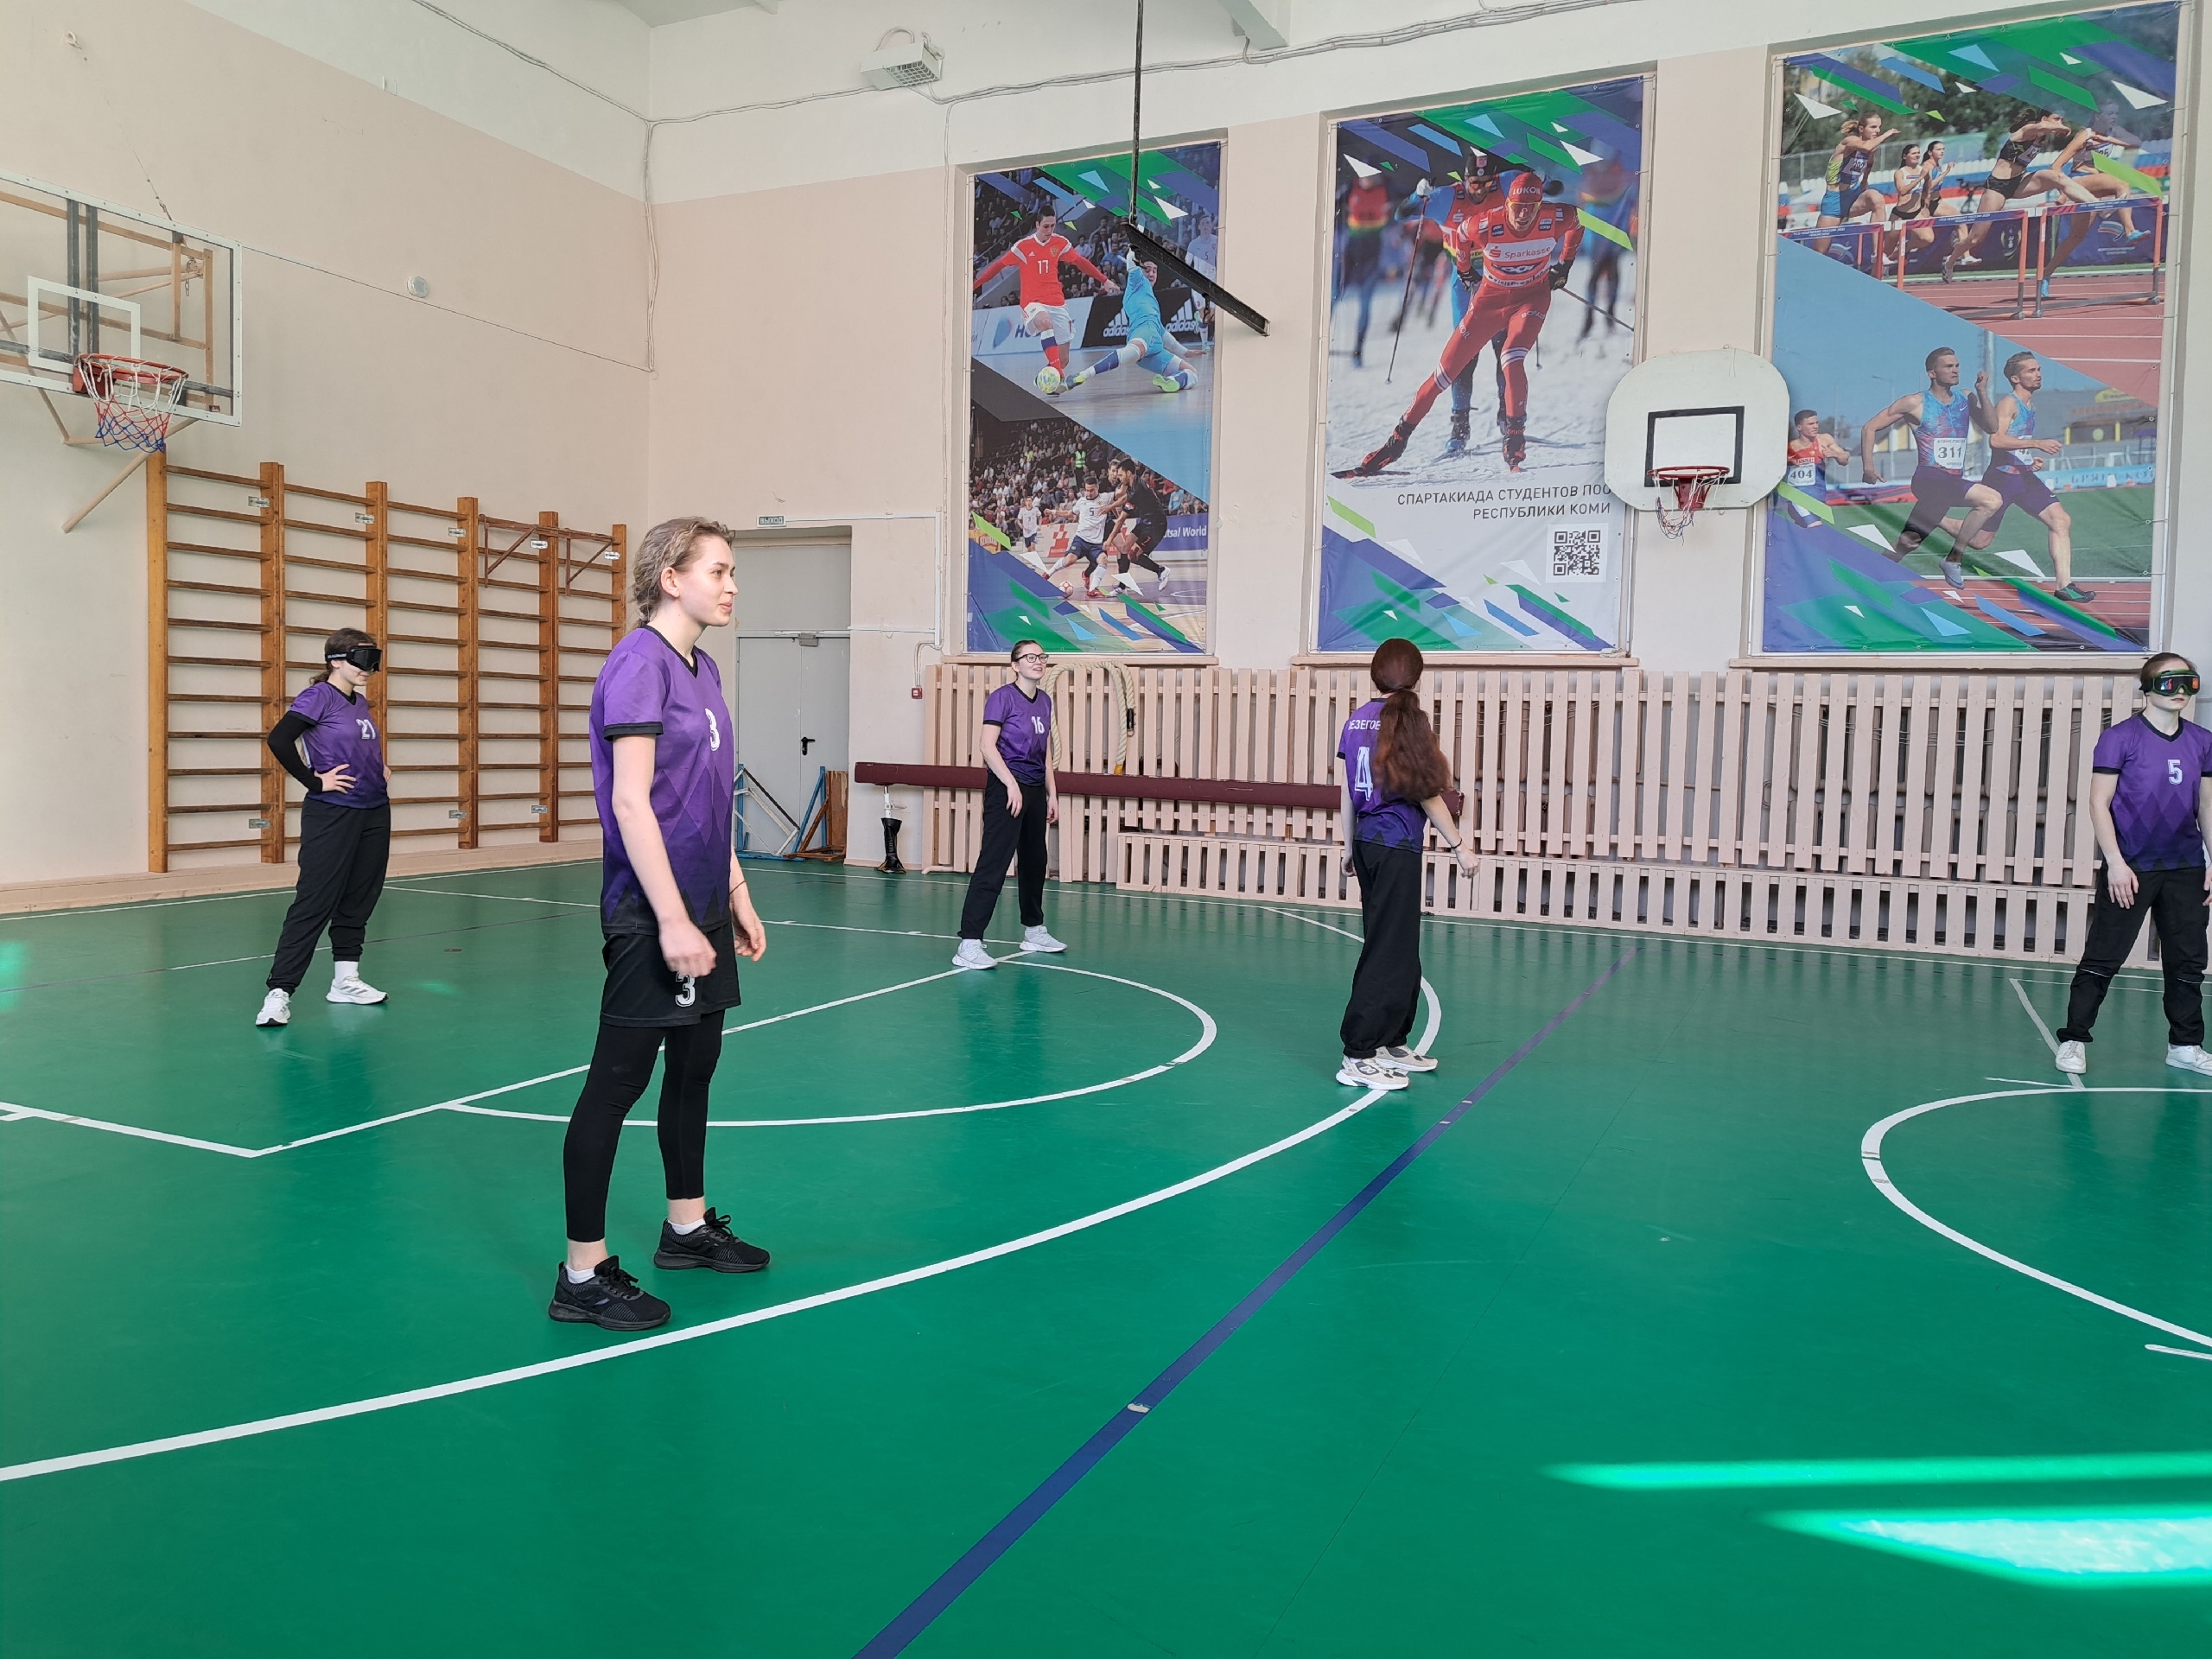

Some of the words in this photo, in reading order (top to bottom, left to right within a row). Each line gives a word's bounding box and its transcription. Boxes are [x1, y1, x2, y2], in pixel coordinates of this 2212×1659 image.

[1504, 246, 1552, 259] Sparkasse
[1037, 259, 1049, 274] 17
[1165, 319, 1195, 333] adidas
[1937, 446, 1962, 459] 311
[1790, 469, 1813, 480] 404
[1397, 490, 1494, 505] СПАРТАКИАДА
[1497, 486, 1578, 501] СТУДЕНТОВ
[1089, 507, 1095, 516] 5
[1473, 505, 1565, 519] РЕСПУБЛИКИ
[1569, 502, 1611, 515] КОМИ
[1182, 524, 1207, 537] World
[355, 718, 377, 740] 21
[704, 708, 721, 752] 3
[1031, 715, 1046, 734] 16
[1354, 746, 1374, 802] 4
[2167, 759, 2183, 785] 5
[675, 971, 696, 1007] 3
